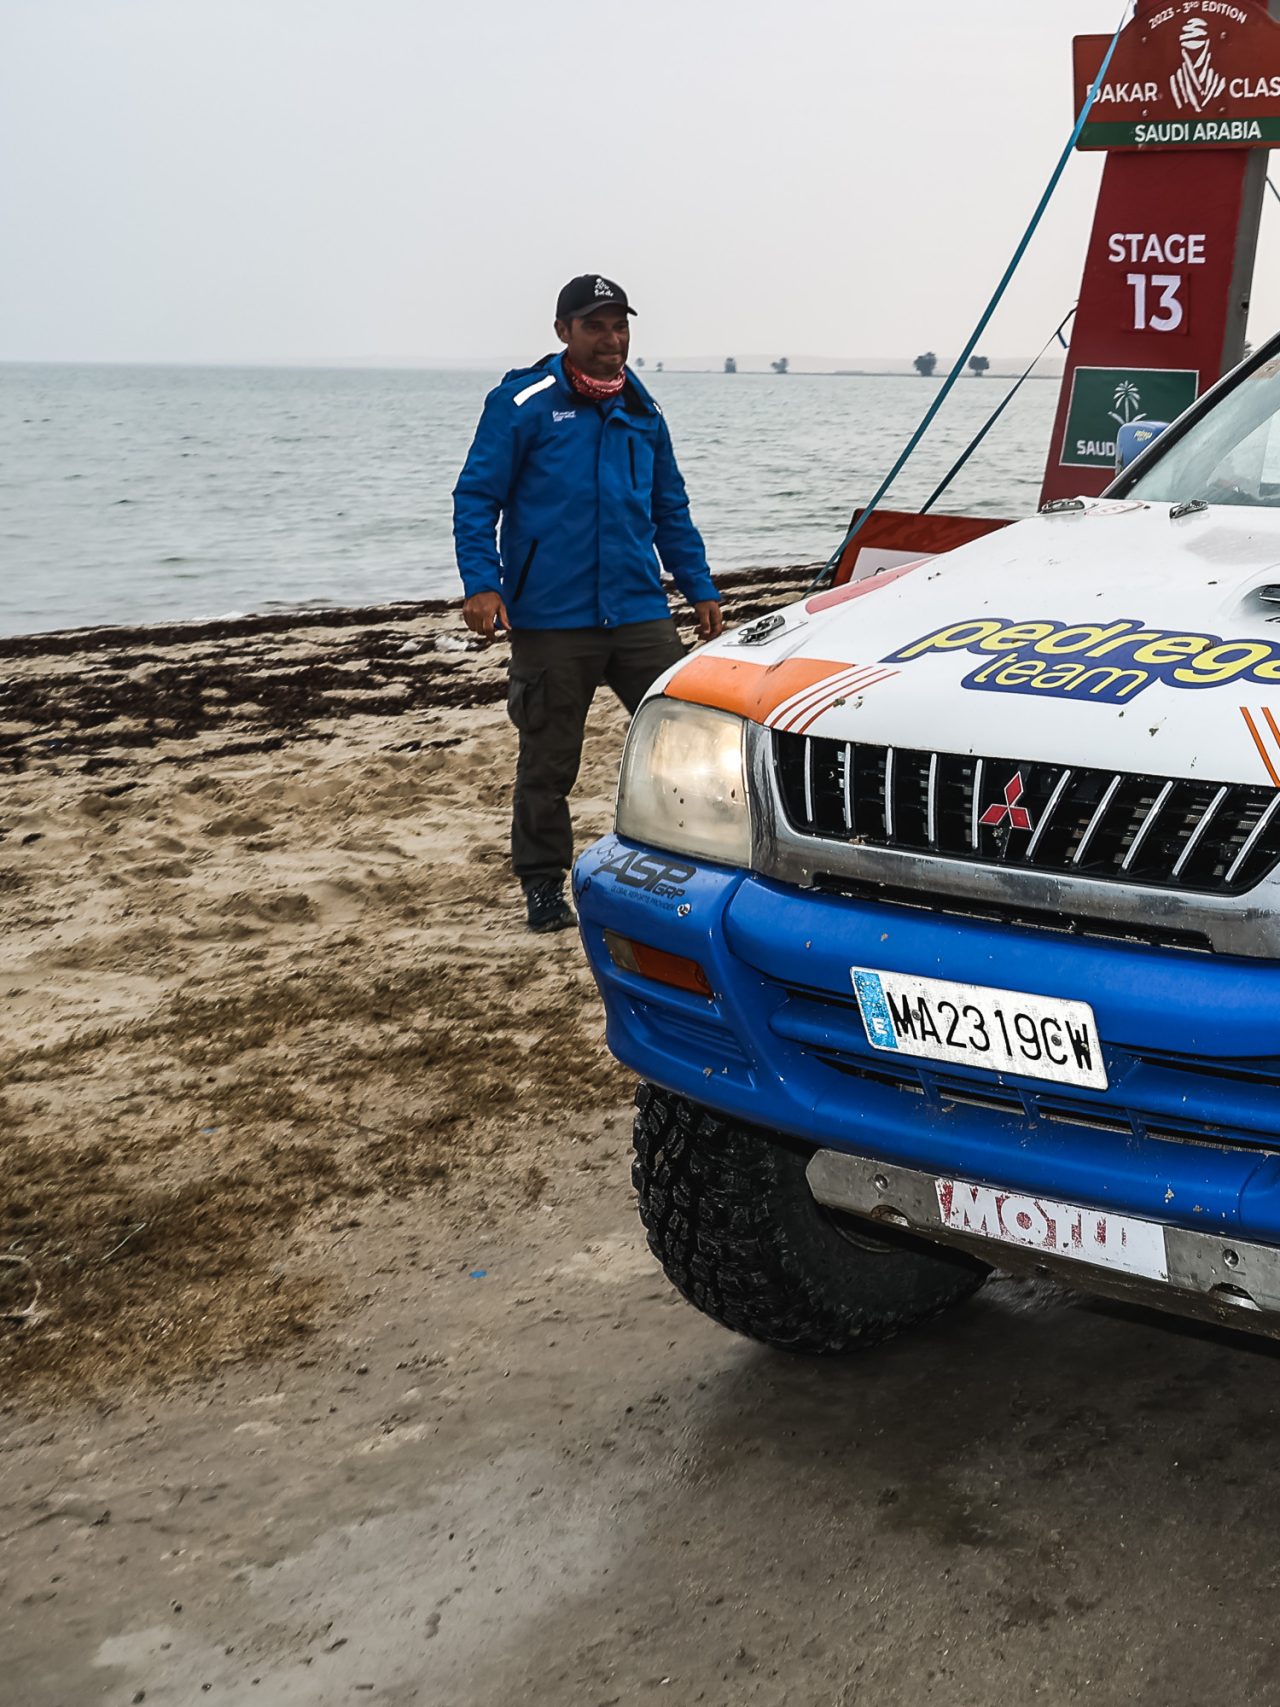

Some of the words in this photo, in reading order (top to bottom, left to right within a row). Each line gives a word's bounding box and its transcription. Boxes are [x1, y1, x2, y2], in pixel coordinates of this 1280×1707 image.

[1201, 1, 1247, 24] EDITION
[1086, 82, 1158, 104] DAKAR
[1134, 124, 1190, 143] SAUDI
[1192, 121, 1262, 141] ARABIA
[1108, 233, 1206, 264] STAGE
[1126, 273, 1183, 331] 13
[1077, 439, 1116, 456] SAUD
[974, 652, 1149, 696] team
[591, 850, 697, 892] ASP
[652, 883, 686, 900] GRP
[873, 1017, 888, 1036] E
